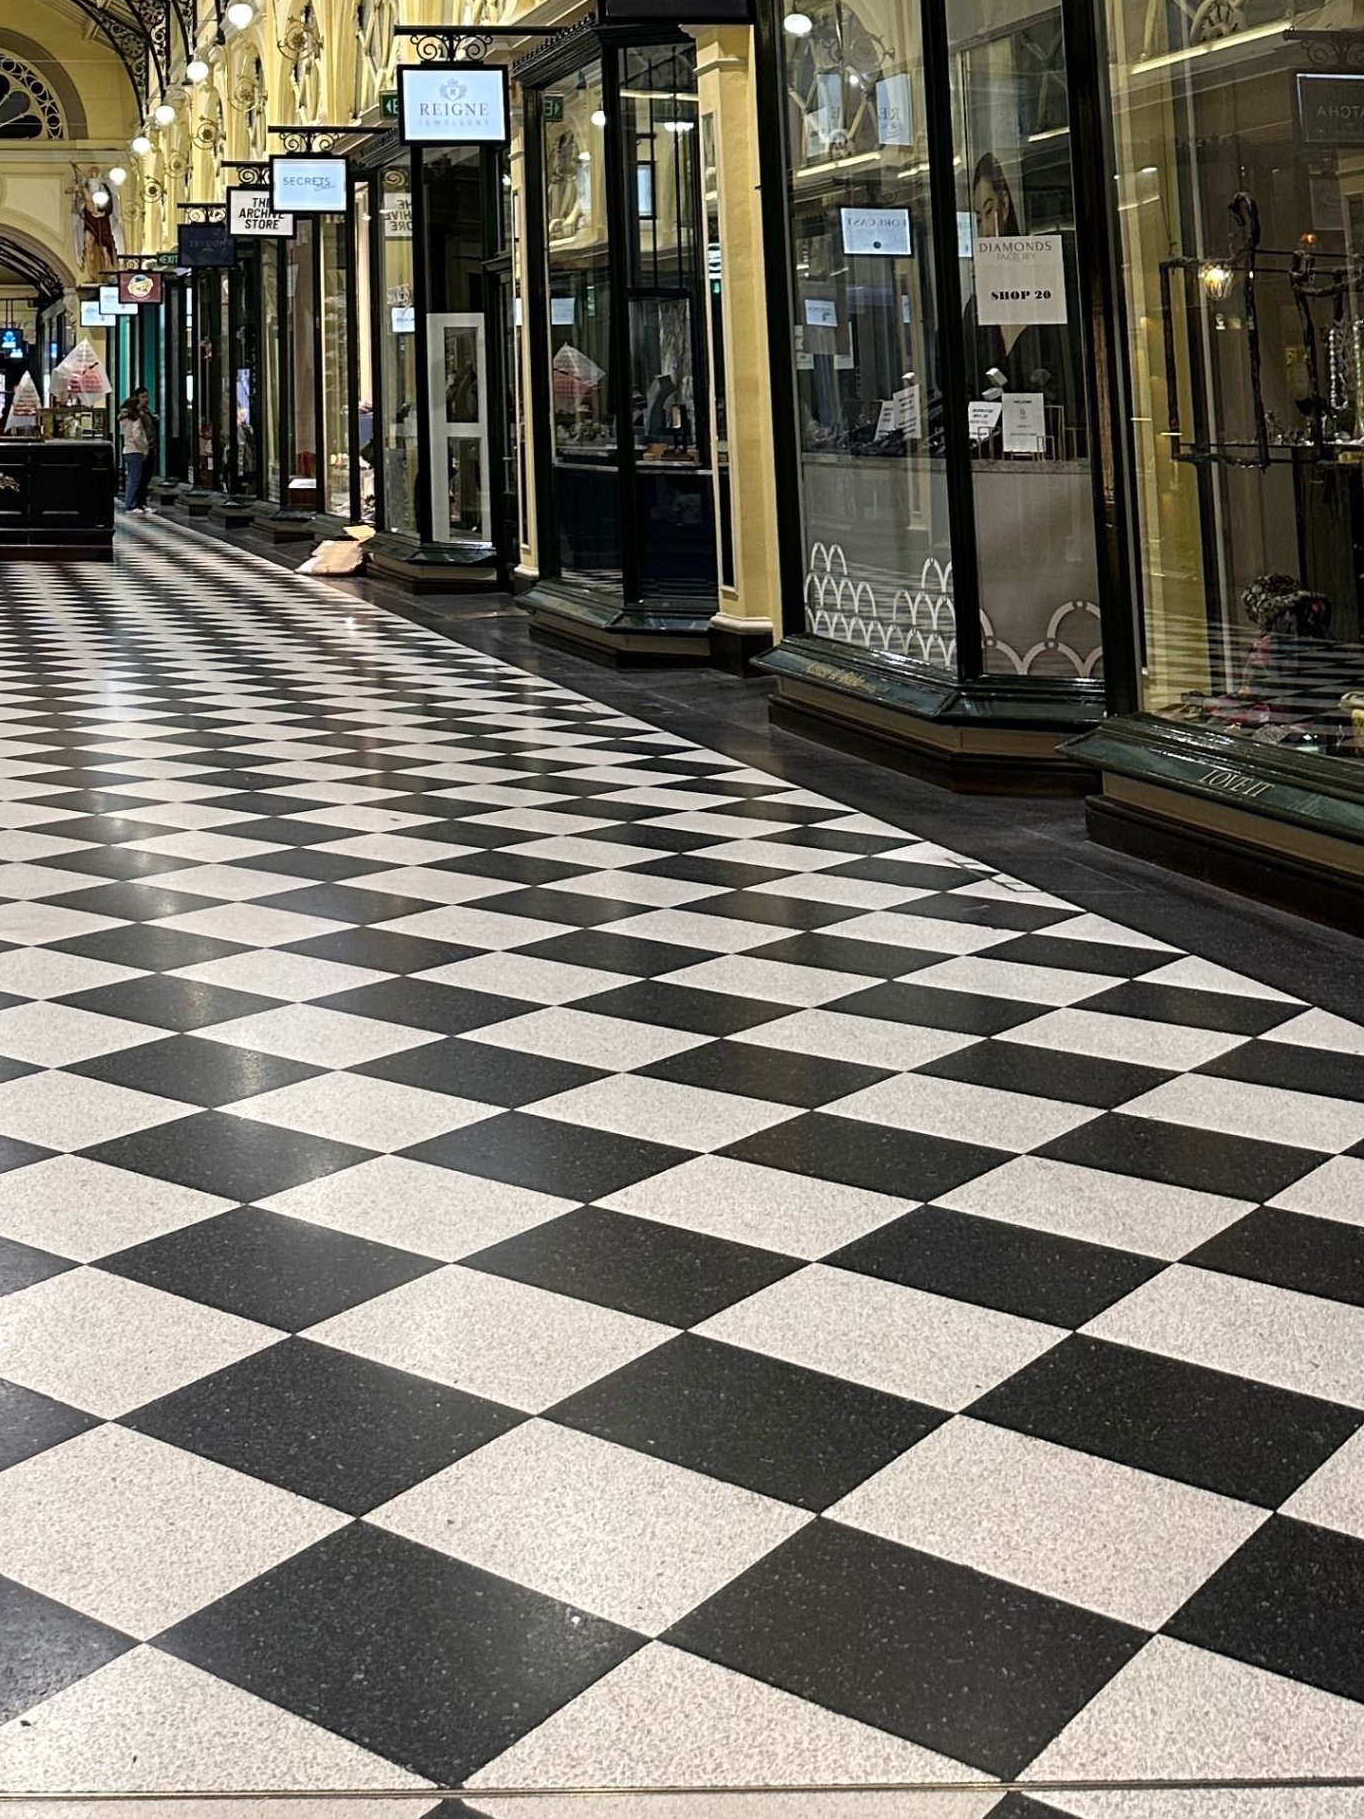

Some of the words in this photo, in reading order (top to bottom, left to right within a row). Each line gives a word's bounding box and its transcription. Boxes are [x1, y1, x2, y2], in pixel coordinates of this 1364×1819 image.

[419, 103, 490, 116] REIGNE
[282, 177, 331, 186] SECRETS
[244, 219, 280, 230] STORE
[979, 241, 1052, 253] DIAMONDS
[990, 290, 1030, 301] SHOP
[1034, 290, 1052, 300] 20
[1199, 769, 1255, 792] LOVE
[1242, 781, 1276, 798] IT
